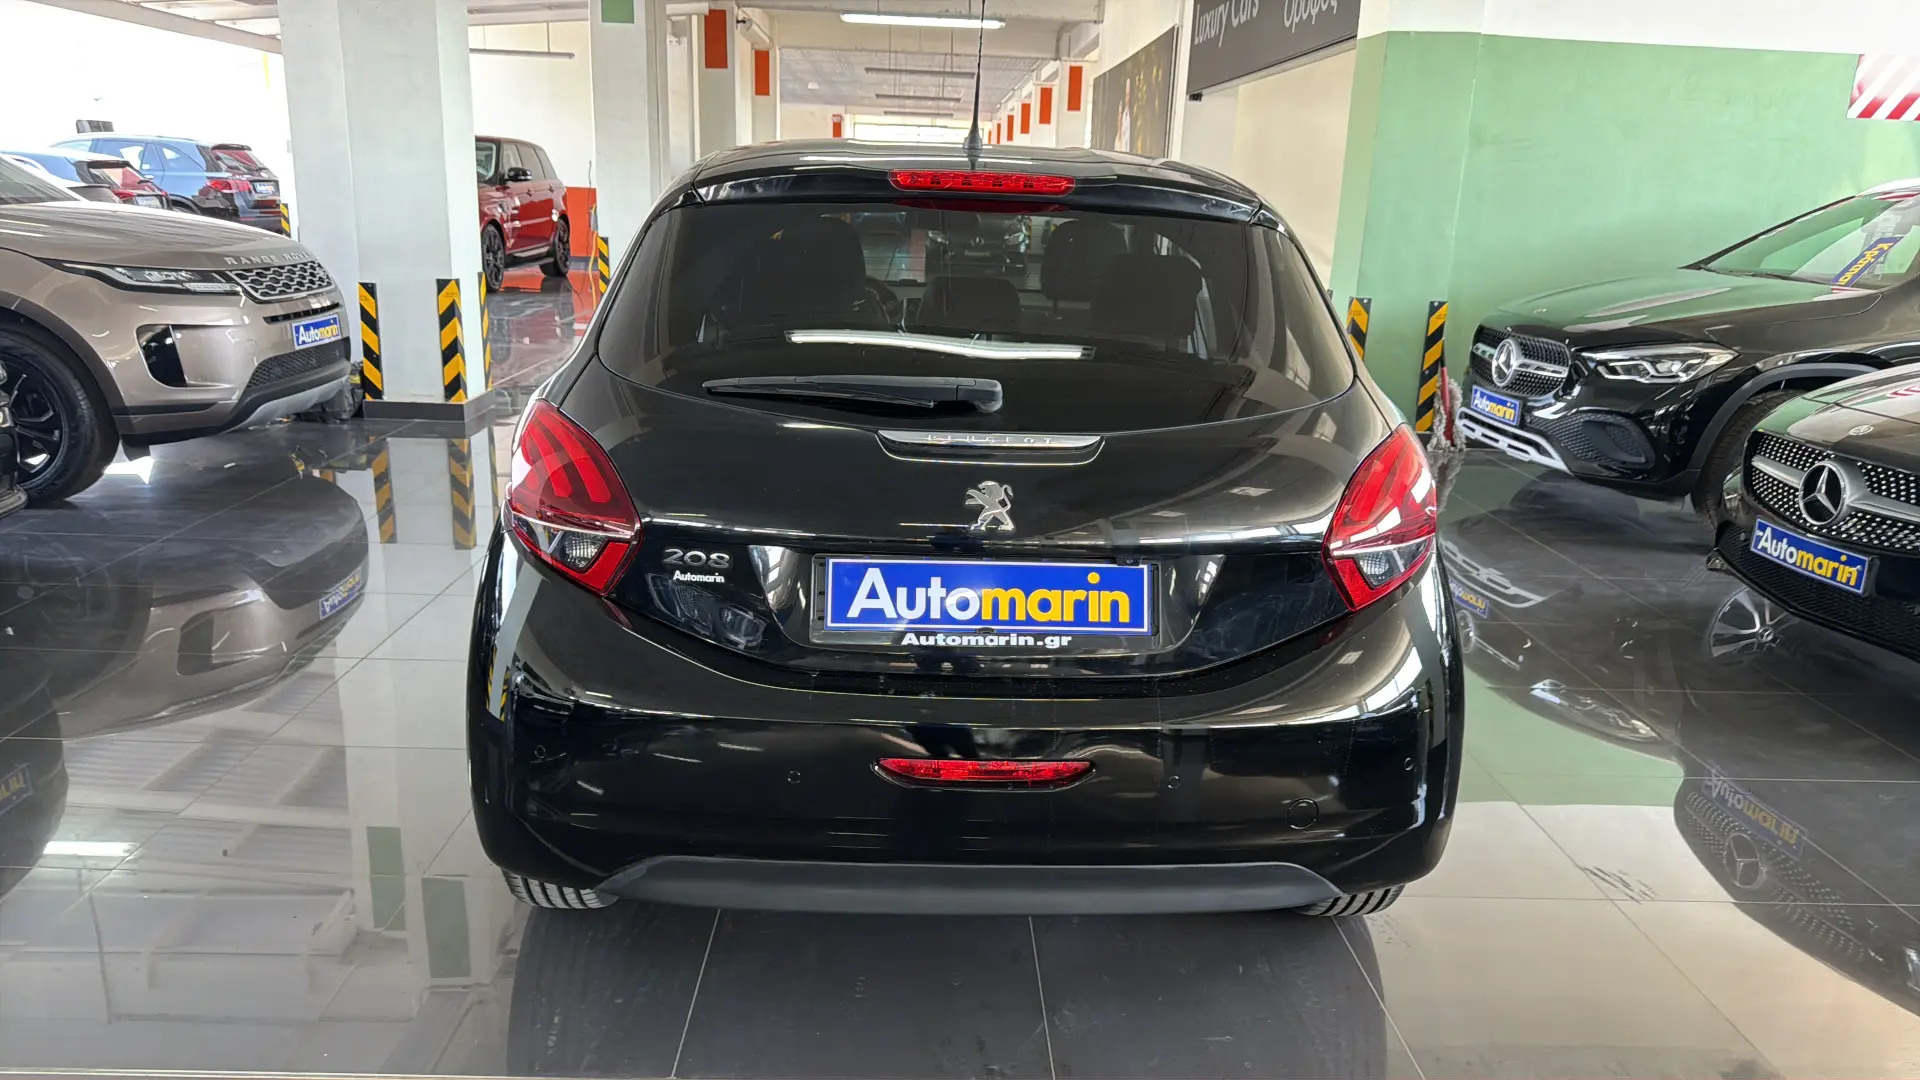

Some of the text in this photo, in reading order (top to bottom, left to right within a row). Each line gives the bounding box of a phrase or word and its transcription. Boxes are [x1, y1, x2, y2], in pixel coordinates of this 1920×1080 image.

[1194, 0, 1260, 48] Luxury Cars
[223, 254, 280, 265] RANGE
[663, 548, 730, 568] 208
[1757, 526, 1858, 586] Automarin
[672, 569, 725, 583] Automarin
[846, 567, 1130, 623] Automarin
[901, 631, 1073, 649] Automarin.gr
